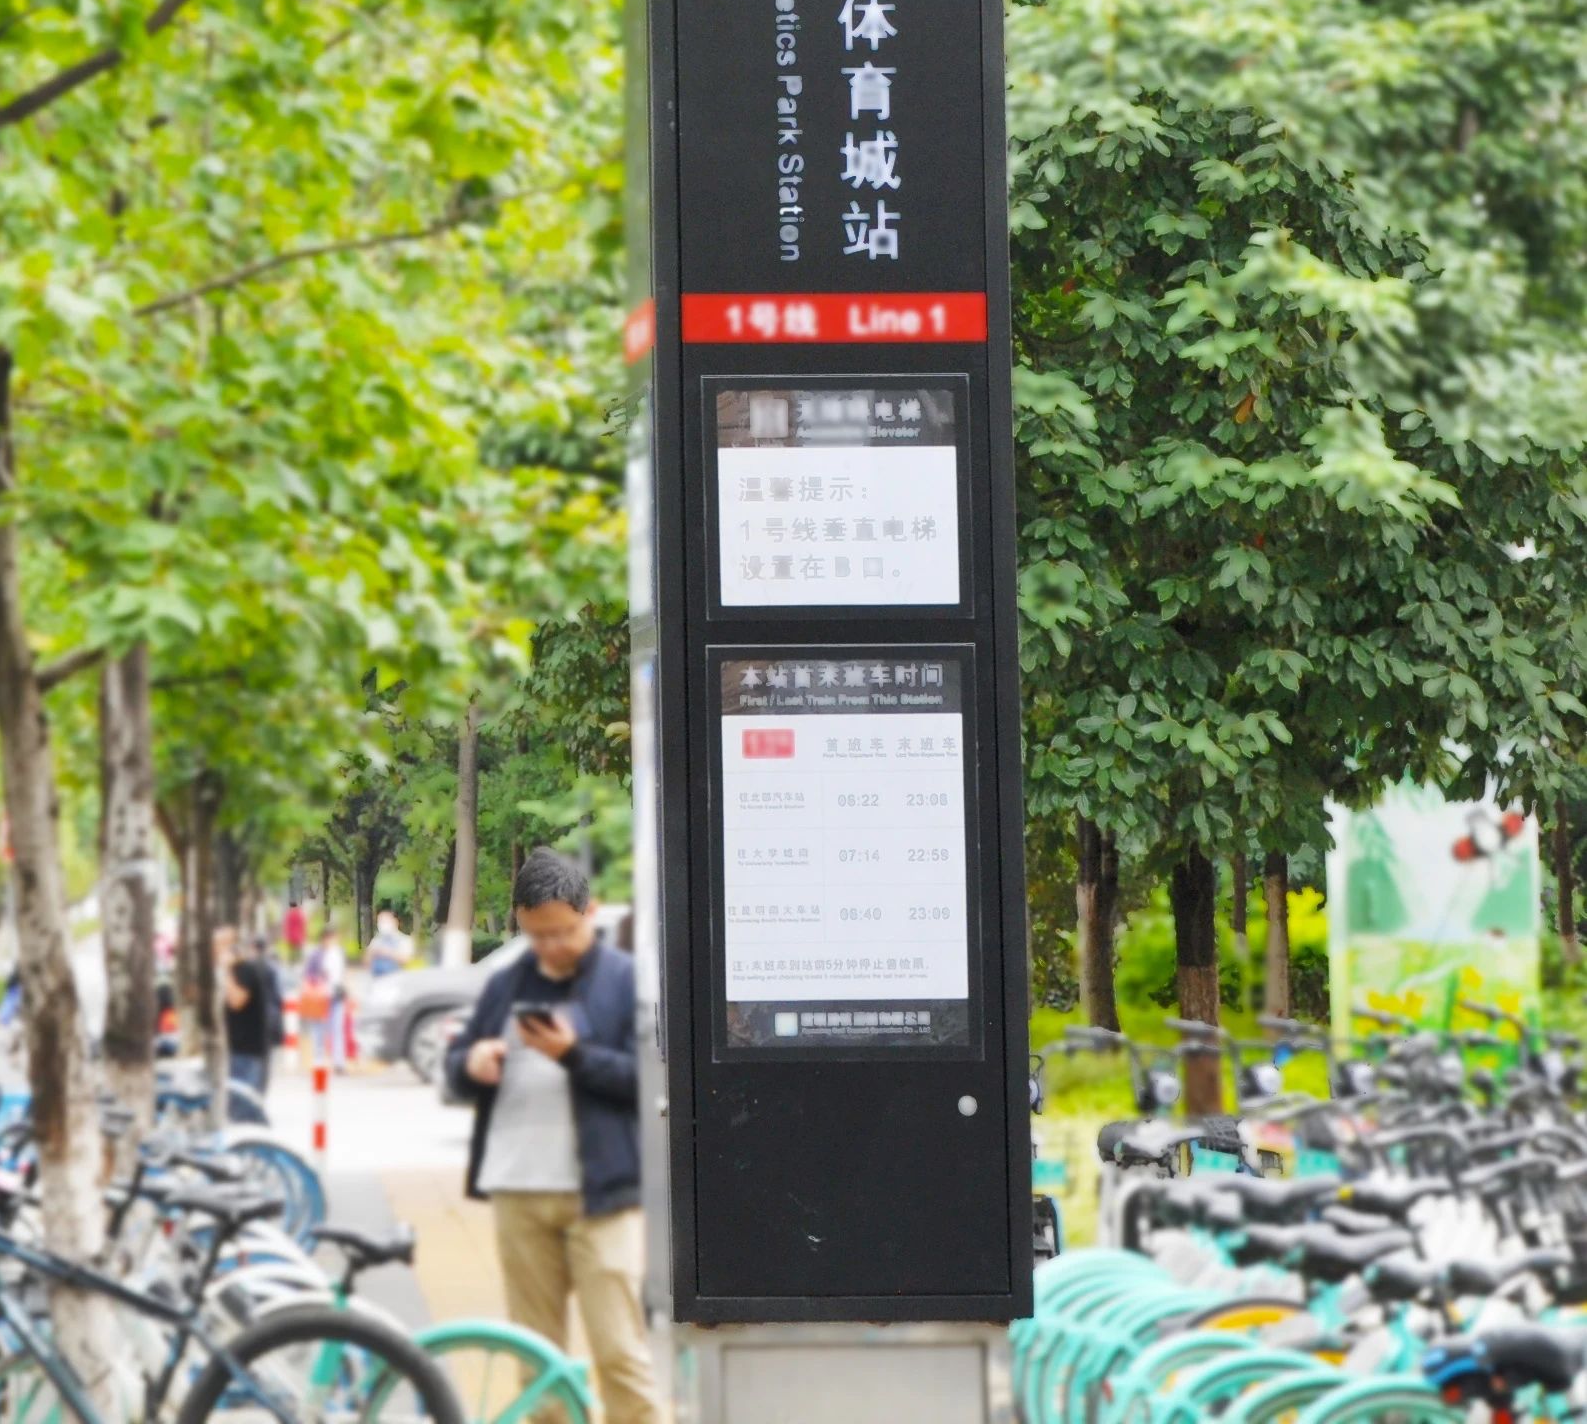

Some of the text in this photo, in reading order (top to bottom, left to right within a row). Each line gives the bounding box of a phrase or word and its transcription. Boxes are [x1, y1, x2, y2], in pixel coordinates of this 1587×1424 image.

[776, 75, 804, 146] Park
[778, 153, 806, 263] Station
[725, 301, 819, 338] 1号线
[848, 303, 947, 336] Line 1
